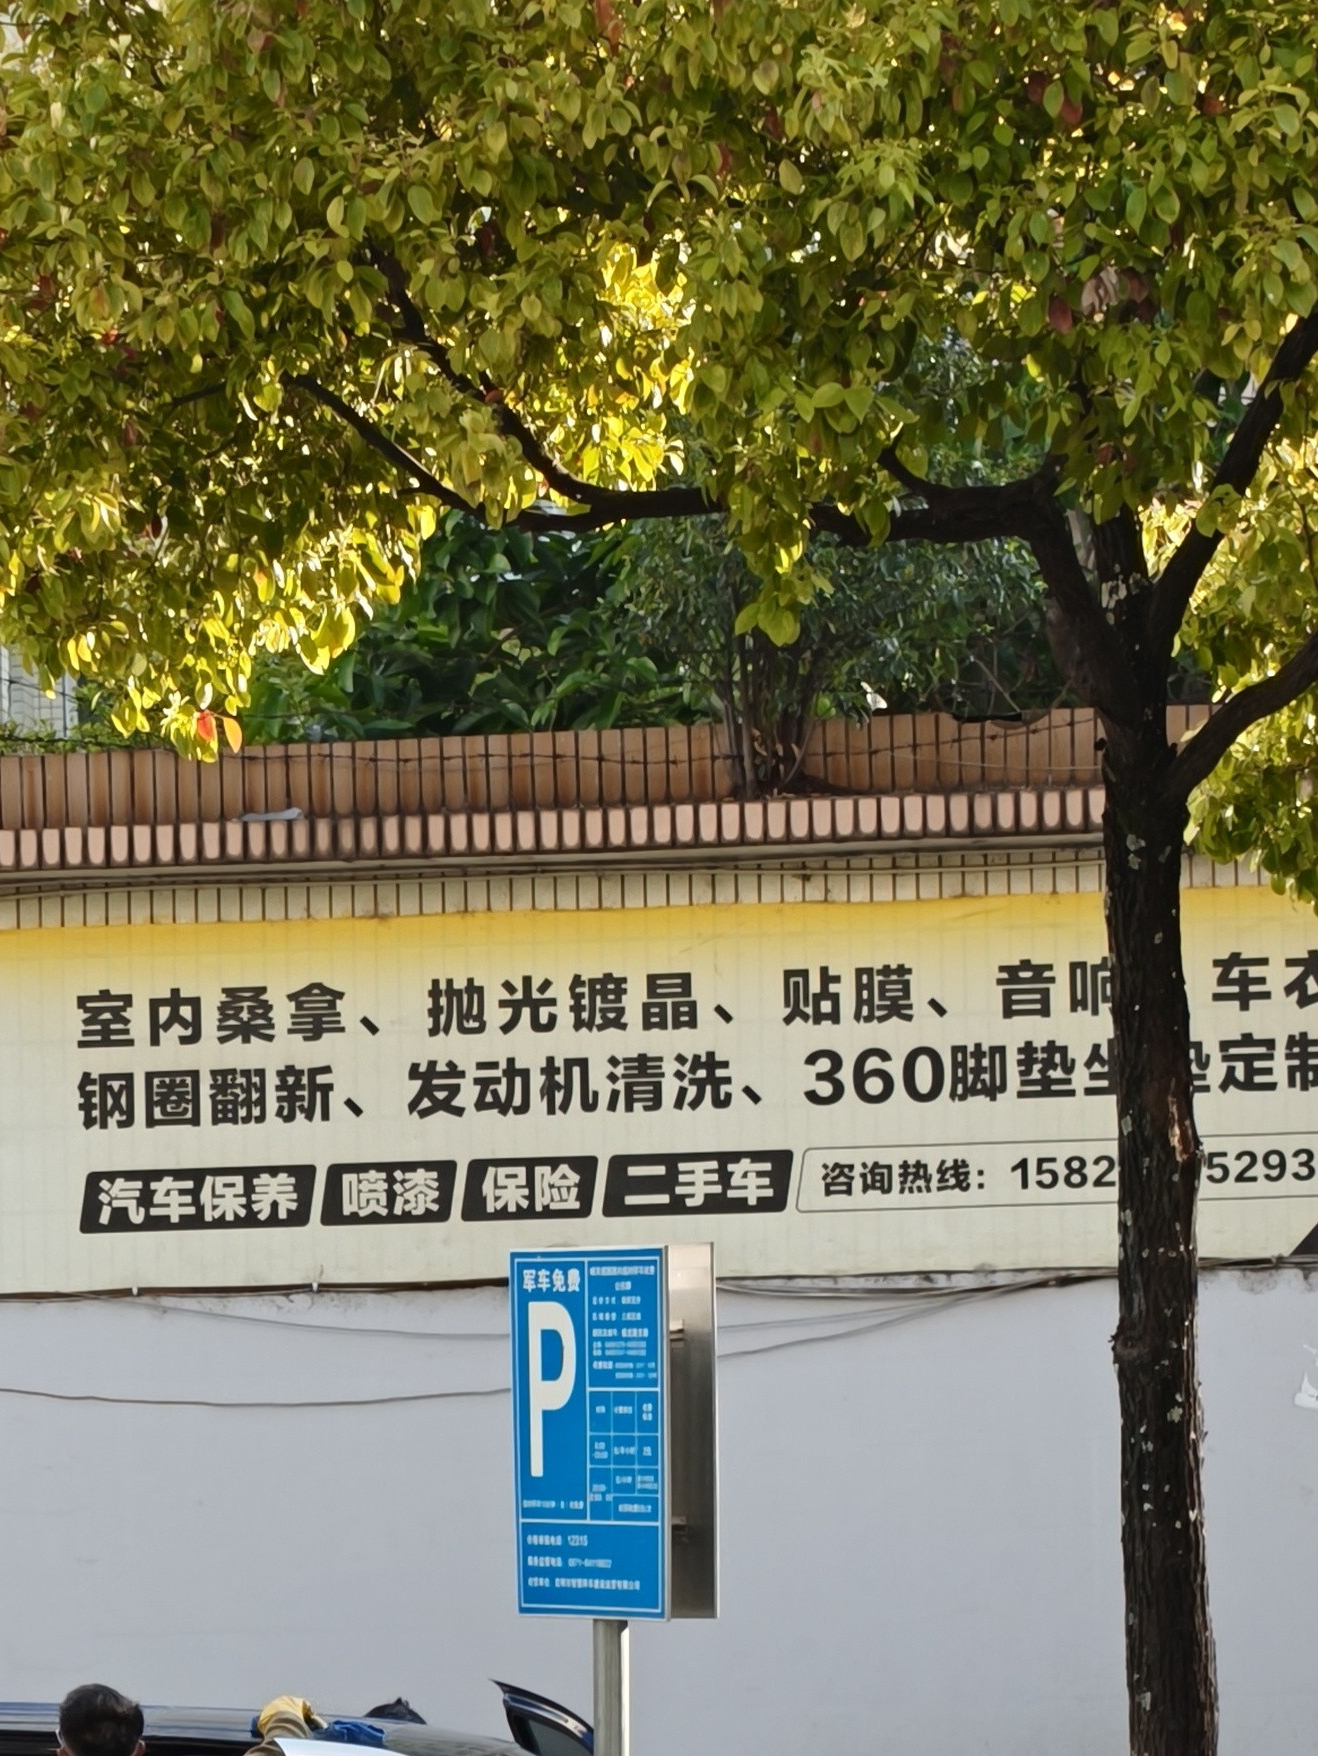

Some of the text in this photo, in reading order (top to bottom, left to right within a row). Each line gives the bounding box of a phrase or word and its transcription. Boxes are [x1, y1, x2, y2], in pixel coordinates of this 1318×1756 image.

[76, 950, 1318, 1049] 室内桑拿、抛光镀晶、贴膜、音响车衣
[342, 1168, 441, 1216] 喷漆
[482, 1164, 581, 1213] 保险
[624, 1157, 774, 1206] 二手车
[1010, 1148, 1318, 1190] 15825293
[98, 1172, 298, 1226] 汽车保养
[528, 1301, 577, 1477] P
